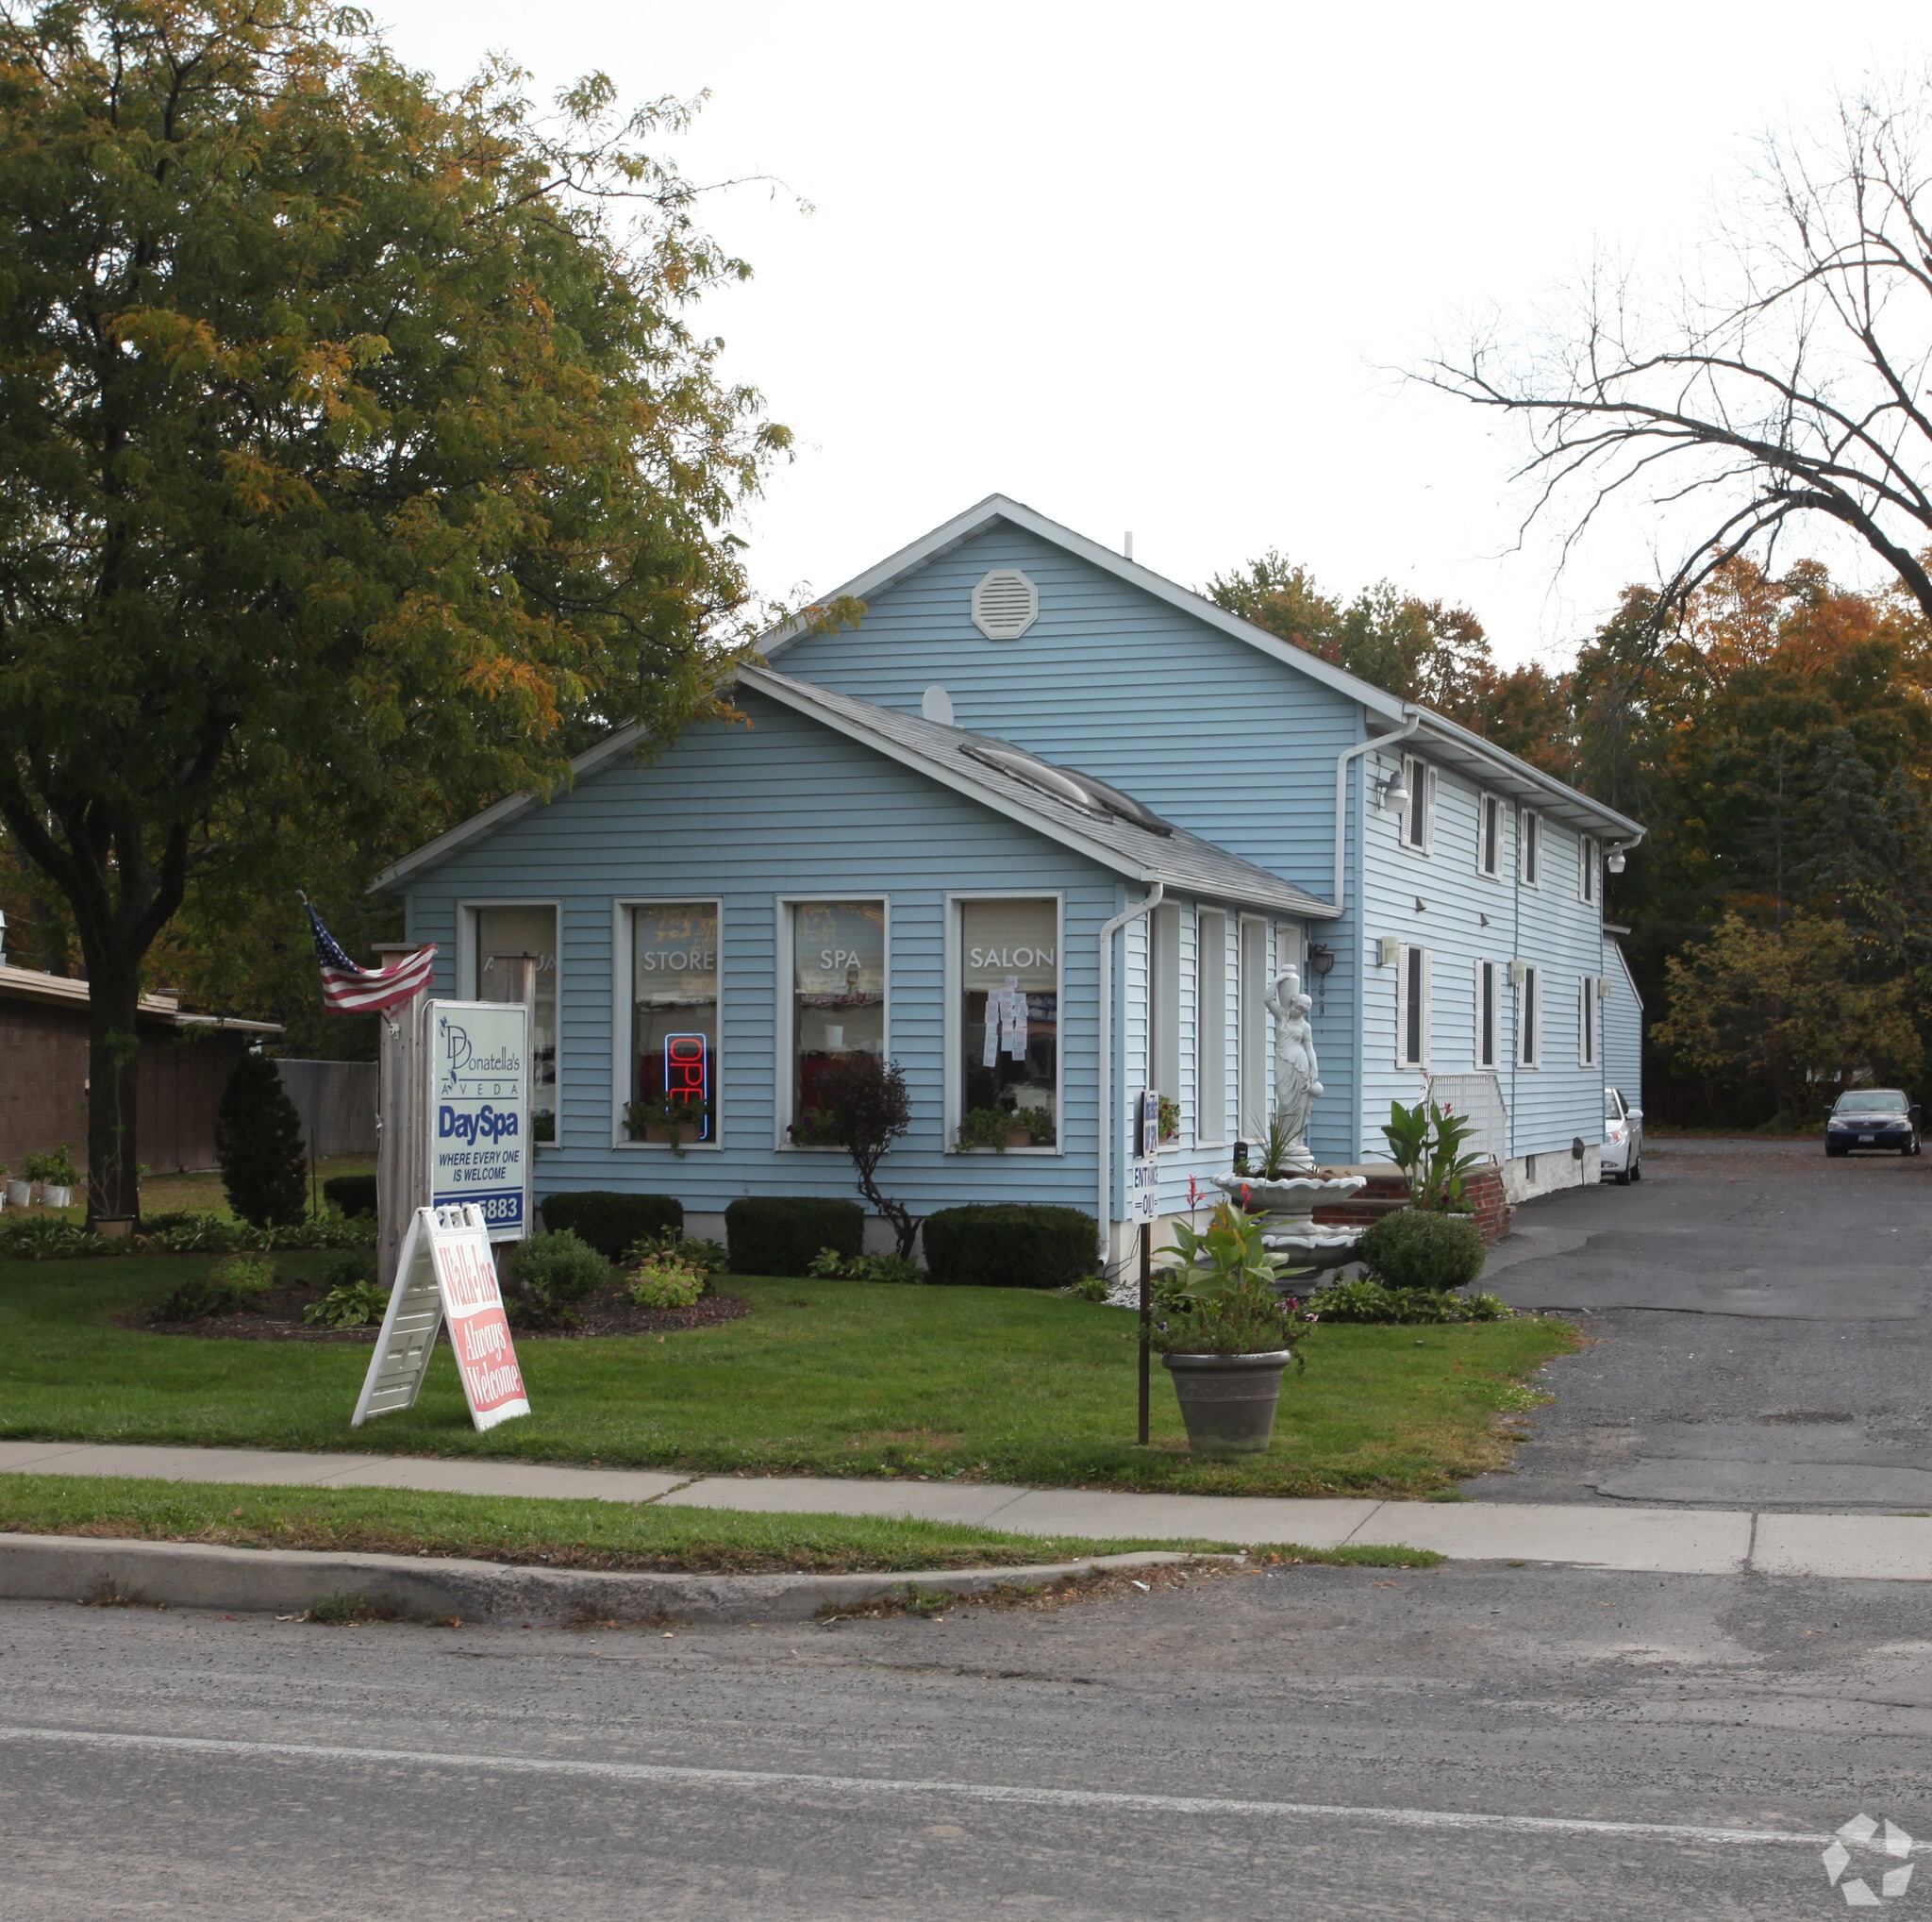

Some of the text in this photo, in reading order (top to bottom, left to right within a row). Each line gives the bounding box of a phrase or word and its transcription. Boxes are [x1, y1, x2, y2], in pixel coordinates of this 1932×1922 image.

[643, 950, 714, 971] STORE
[821, 949, 861, 970] SPA
[970, 947, 1054, 968] SALON
[441, 1083, 518, 1095] AVEDA
[670, 1039, 704, 1135] OPE
[439, 1105, 518, 1145] DaySpa
[440, 1150, 520, 1166] WHERE EVERY ONE
[453, 1167, 507, 1182] IS WELCOME
[439, 1244, 497, 1306] Walk-Ins
[464, 1319, 506, 1362] Always
[466, 1361, 521, 1404] Welcome
